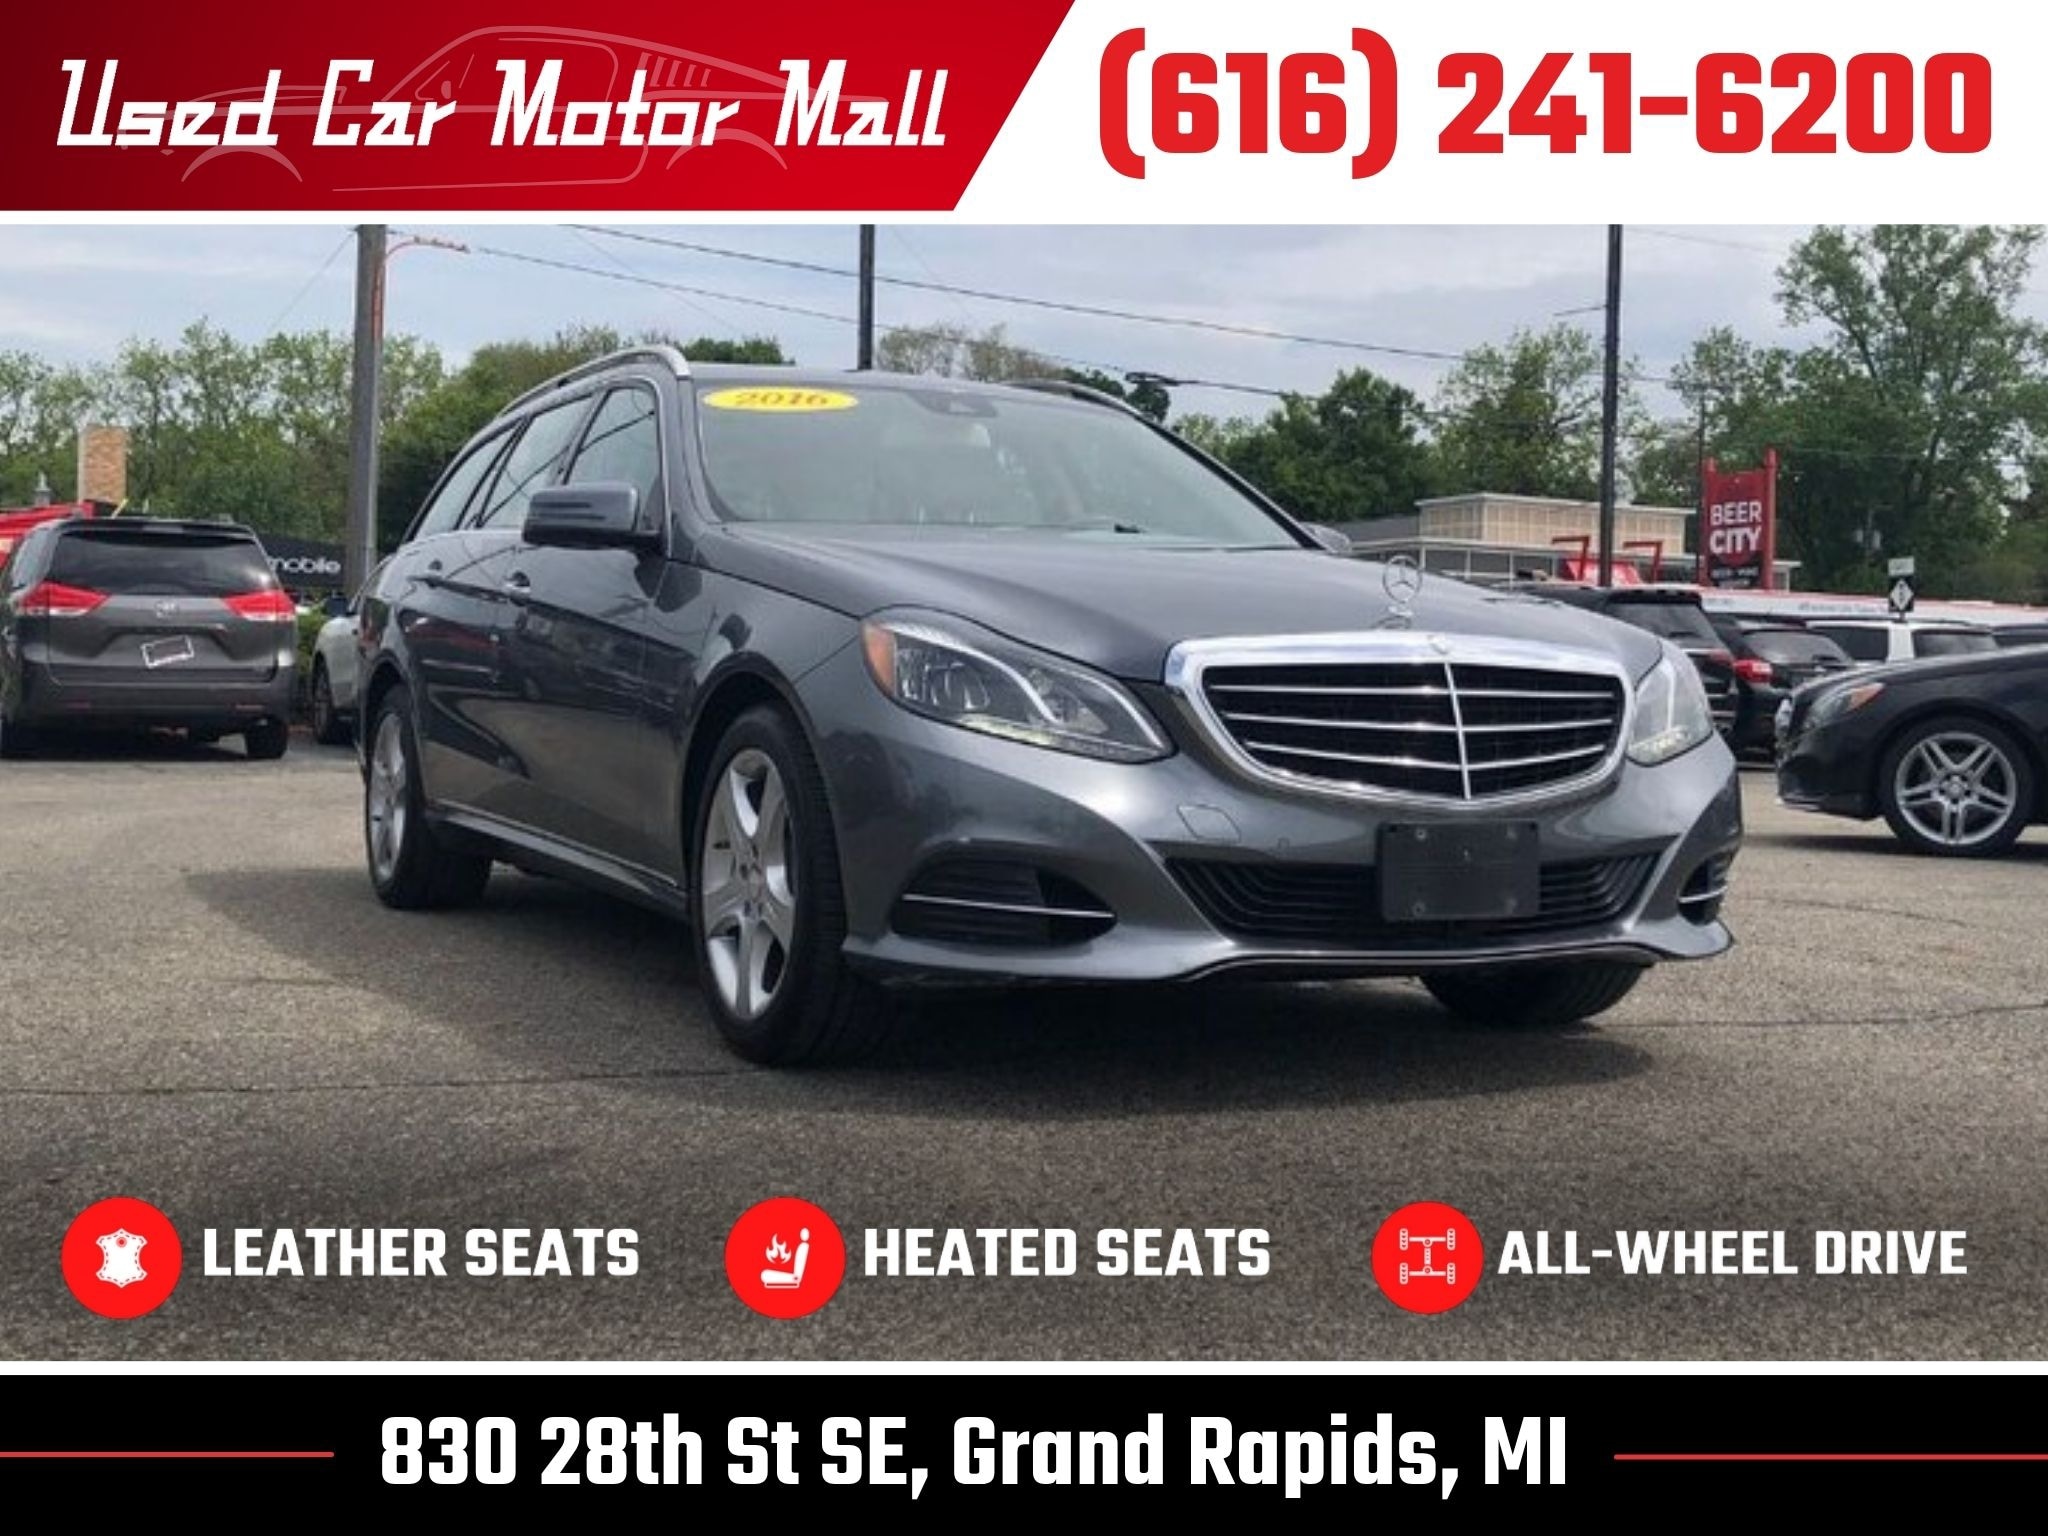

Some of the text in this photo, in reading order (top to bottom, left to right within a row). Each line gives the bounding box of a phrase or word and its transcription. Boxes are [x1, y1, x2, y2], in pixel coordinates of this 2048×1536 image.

[733, 389, 830, 408] 2016
[1710, 501, 1762, 526] BEER
[1710, 525, 1762, 553] CITY
